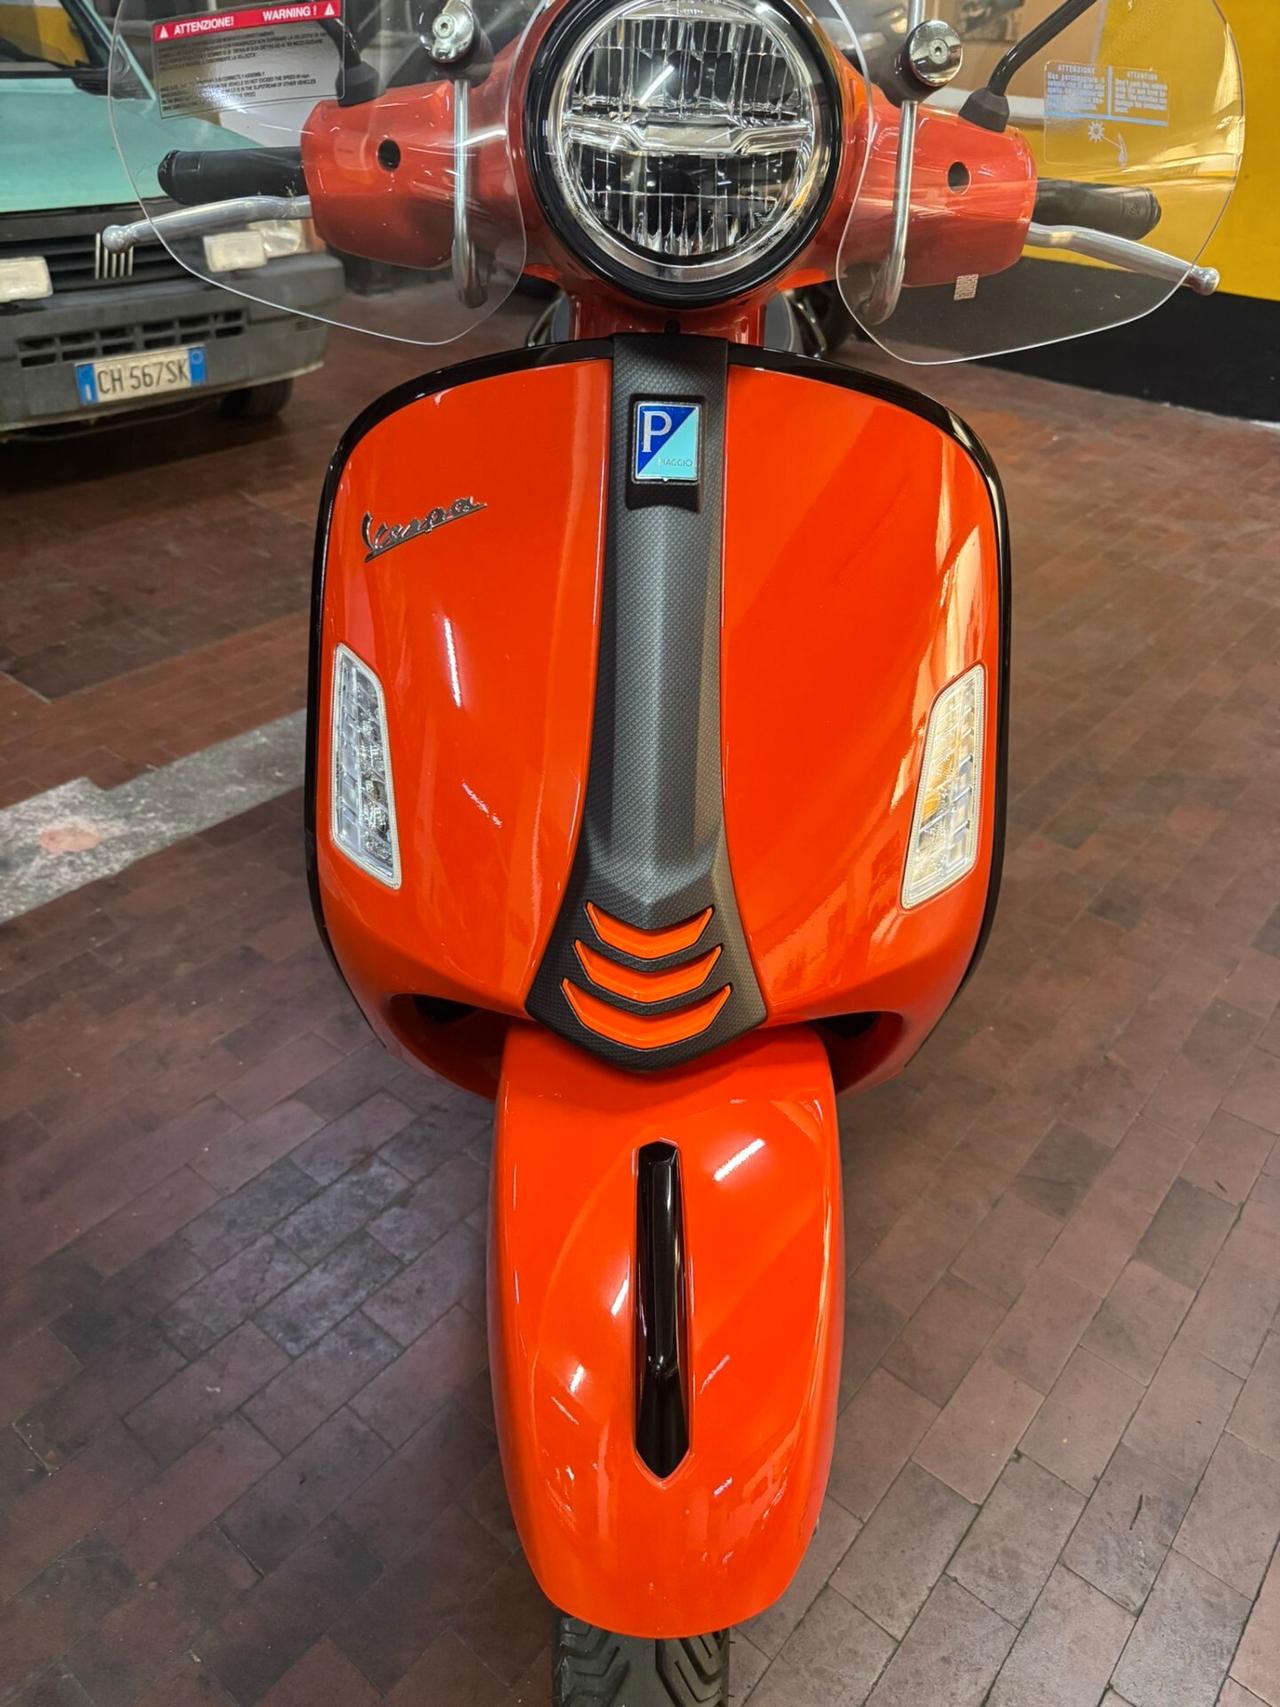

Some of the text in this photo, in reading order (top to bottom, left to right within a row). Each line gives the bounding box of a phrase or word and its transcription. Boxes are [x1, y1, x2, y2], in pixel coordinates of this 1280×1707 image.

[173, 16, 234, 35] ATTENZIONE!
[262, 6, 311, 22] WARNING
[97, 367, 124, 395] CH
[641, 410, 673, 453] P
[361, 495, 488, 563] Vespa
